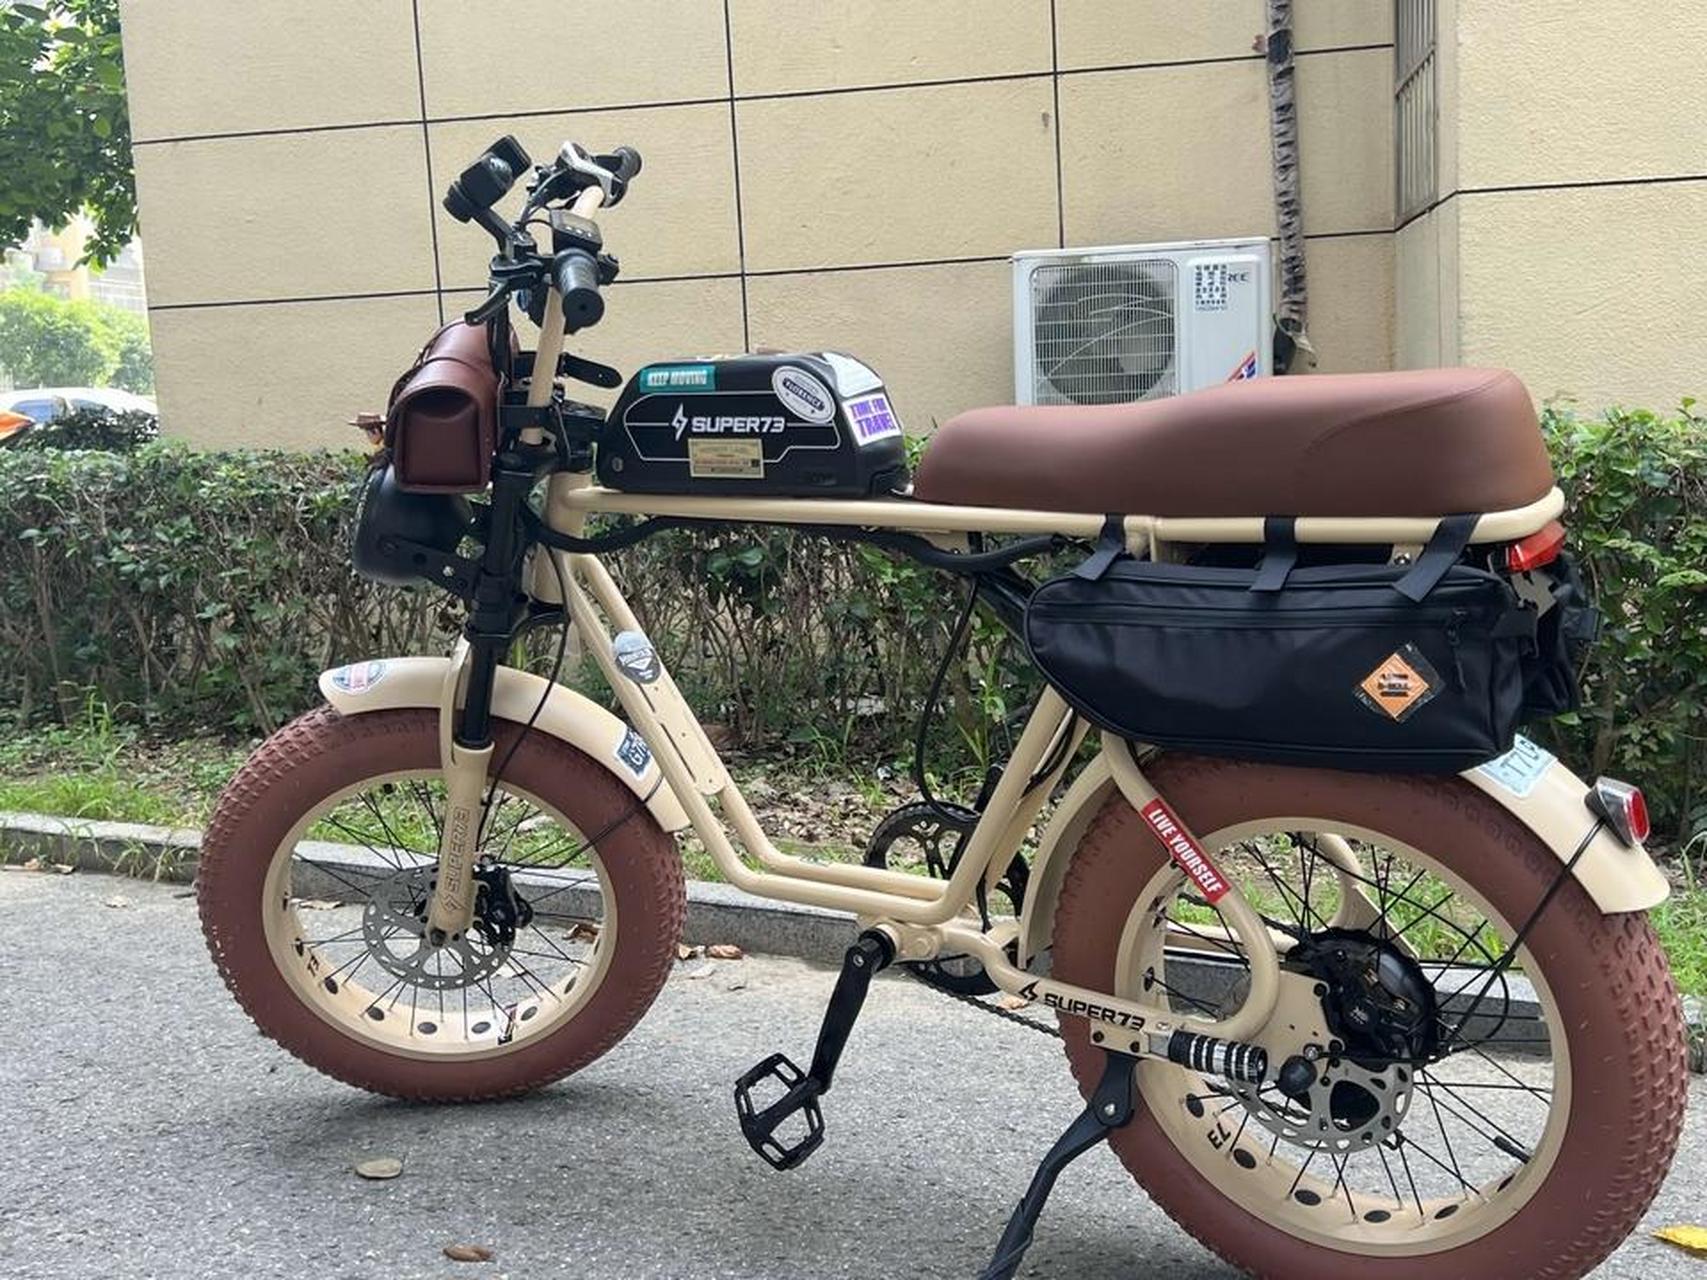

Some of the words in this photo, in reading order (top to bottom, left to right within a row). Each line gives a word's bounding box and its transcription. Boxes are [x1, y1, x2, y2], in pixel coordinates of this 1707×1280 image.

[692, 416, 785, 433] SUPER73
[1148, 809, 1177, 838] LIVE
[1169, 834, 1223, 893] YOURSELF
[1043, 993, 1146, 1031] SUPER73
